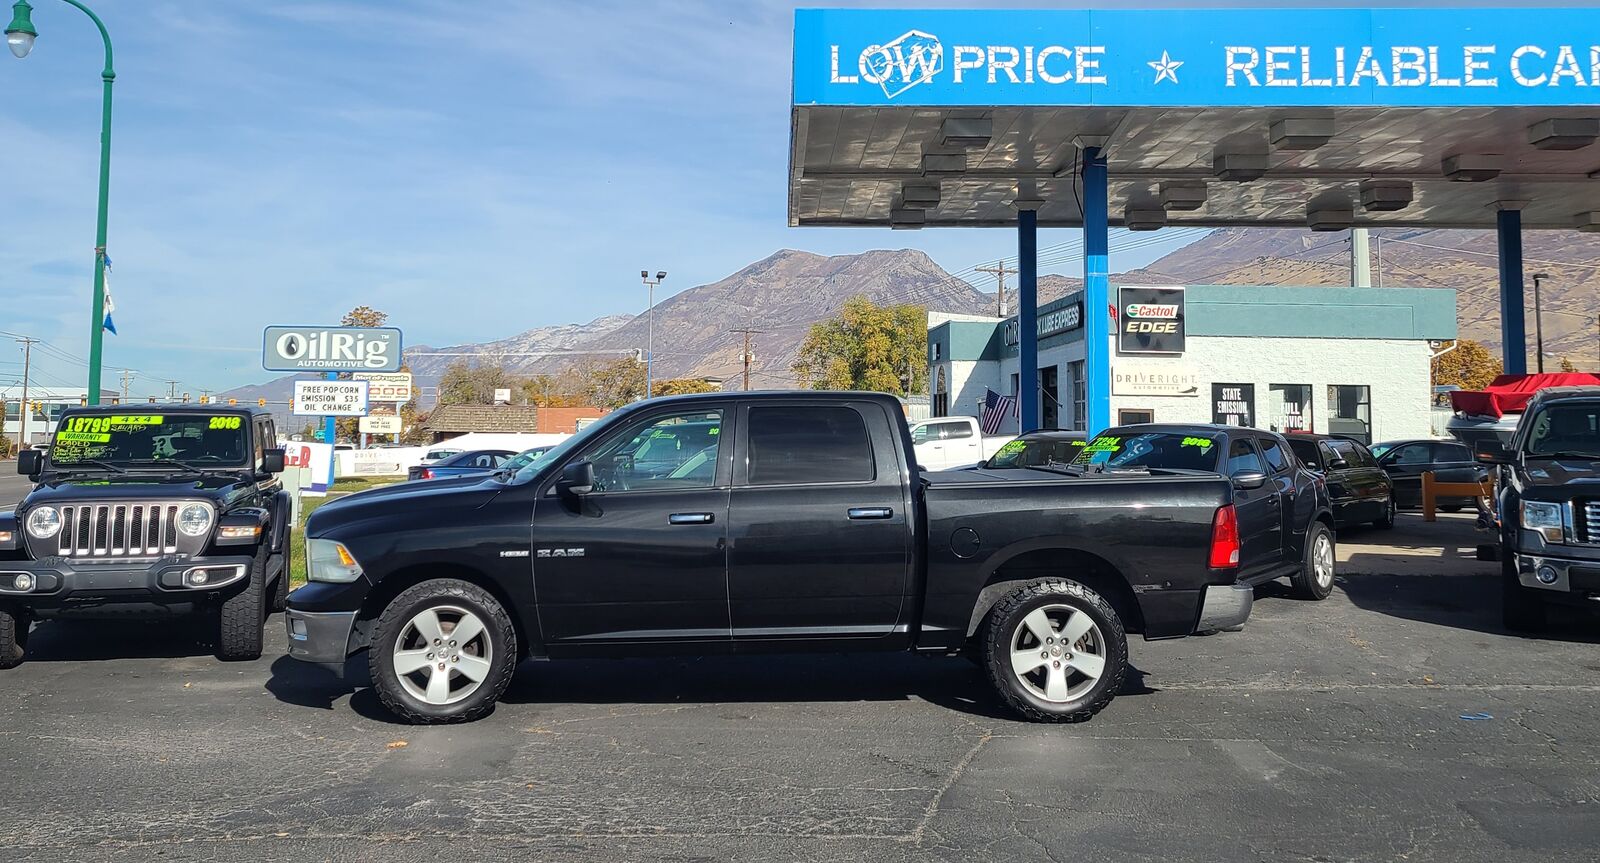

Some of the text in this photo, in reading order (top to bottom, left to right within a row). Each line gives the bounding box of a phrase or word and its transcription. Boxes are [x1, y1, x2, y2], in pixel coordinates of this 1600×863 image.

[829, 44, 1108, 85] LOW PRICE
[1224, 45, 1498, 87] RELIABLE
[1139, 305, 1174, 317] Castrol
[1042, 314, 1054, 334] LUBE
[1055, 305, 1080, 330] EXPRESS
[1126, 322, 1178, 333] EDGE
[276, 331, 389, 368] OilRig
[297, 360, 364, 368] AUTOMOTIVE
[1116, 372, 1196, 384] DRIVERIGHT
[302, 386, 321, 394] FREE
[1222, 388, 1241, 400] STATE
[301, 395, 336, 403] EMISSION
[304, 403, 352, 411] OIL CHANGE
[1217, 401, 1248, 413] EMISSION
[1281, 402, 1300, 414] FULL
[66, 417, 111, 433] 18799
[209, 416, 241, 430] 2018
[1226, 414, 1239, 426] AND
[1273, 415, 1307, 429] SERVICE
[64, 433, 102, 441] WARRANTY
[537, 548, 585, 558] RAM
